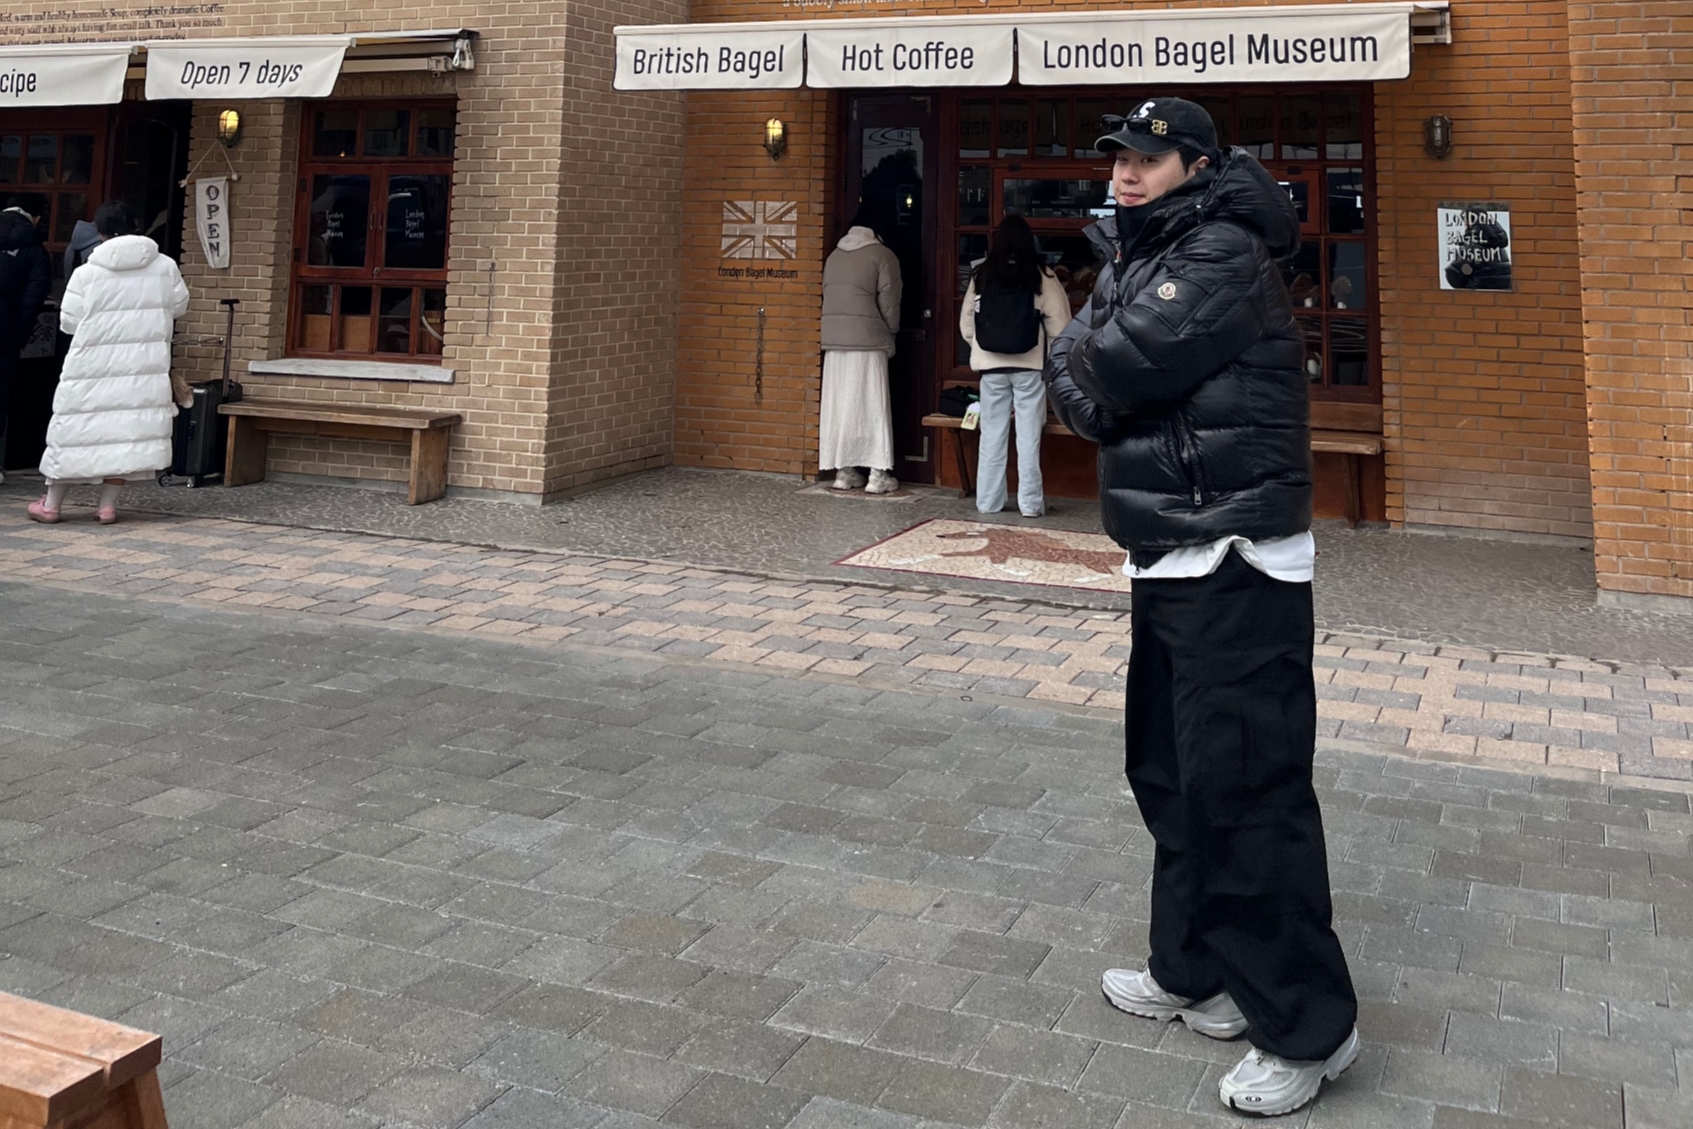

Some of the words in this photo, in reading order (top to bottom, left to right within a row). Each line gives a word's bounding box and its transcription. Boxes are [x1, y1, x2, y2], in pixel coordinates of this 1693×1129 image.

[632, 47, 709, 75] British
[717, 44, 785, 79] Bagel
[841, 43, 885, 71] Hot
[892, 41, 975, 71] Coffee
[1043, 37, 1143, 70] London
[1154, 33, 1235, 73] Bagel
[1246, 32, 1379, 65] Museum
[0, 68, 37, 98] cipe
[180, 61, 230, 90] Open
[238, 61, 251, 85] 7
[256, 59, 304, 90] days
[205, 184, 220, 258] OPEN
[1446, 229, 1488, 245] BAGEL
[1446, 247, 1502, 262] MUSEUM
[717, 266, 744, 277] London
[745, 266, 766, 280] Bagel
[766, 267, 799, 279] Museum
